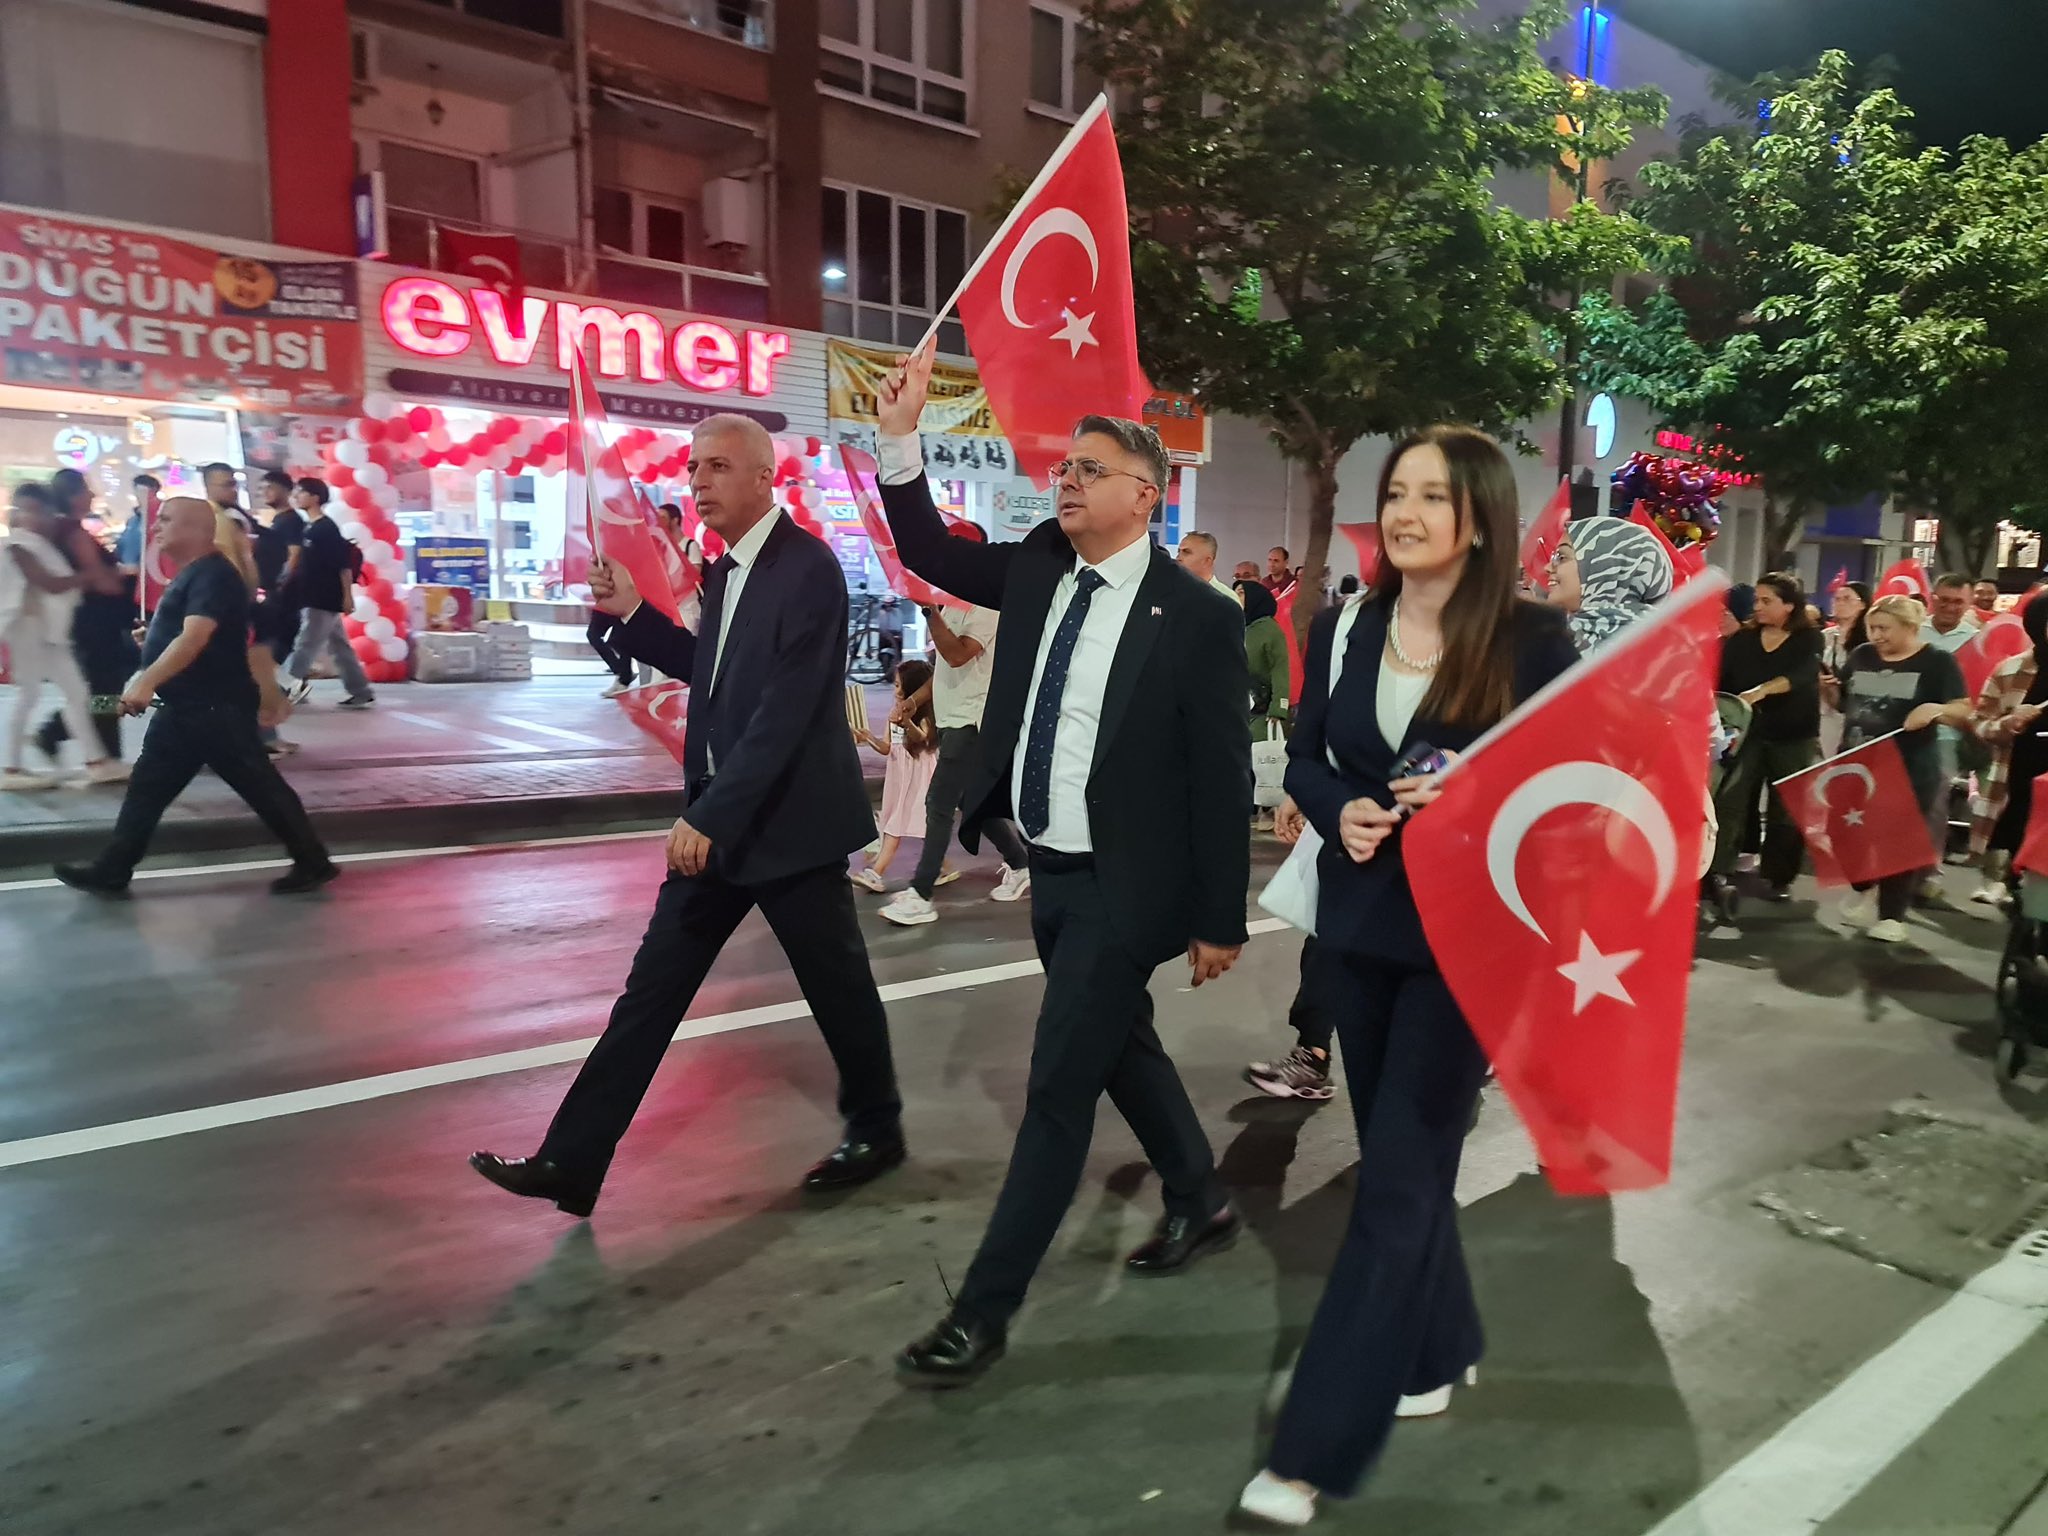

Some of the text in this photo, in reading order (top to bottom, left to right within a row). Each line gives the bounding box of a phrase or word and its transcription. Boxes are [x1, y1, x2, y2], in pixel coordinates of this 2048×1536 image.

[19, 219, 116, 256] SİVAS
[0, 250, 216, 318] DÜĞÜN
[0, 297, 327, 374] PAKETÇİSİ
[381, 276, 790, 397] evmer
